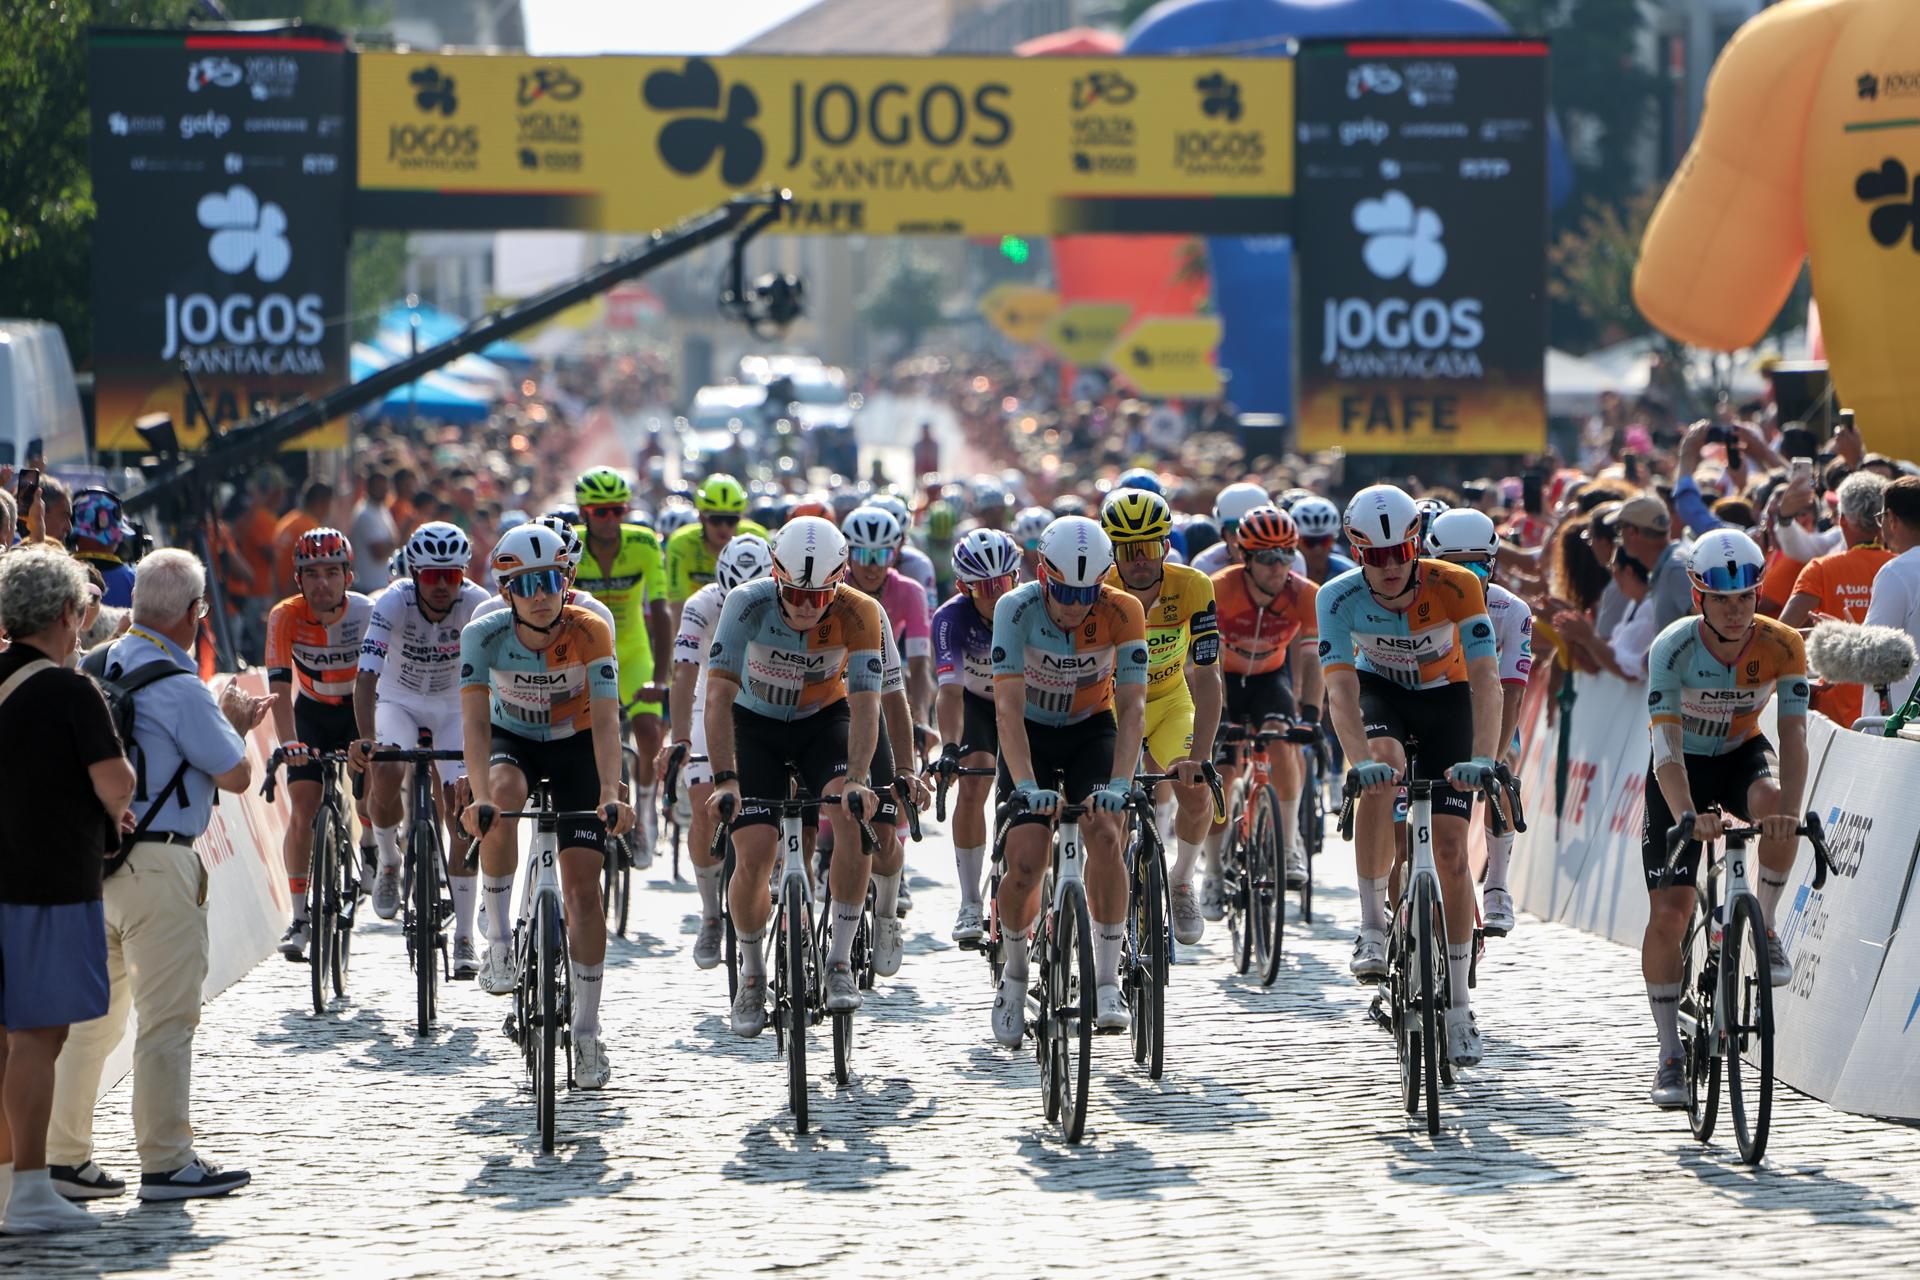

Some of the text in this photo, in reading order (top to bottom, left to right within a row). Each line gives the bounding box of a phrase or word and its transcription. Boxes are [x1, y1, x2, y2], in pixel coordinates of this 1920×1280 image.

[785, 80, 1013, 170] JOGOS
[387, 125, 479, 163] JOGOS
[1174, 130, 1265, 168] JOGOS
[811, 156, 1013, 191] SANTACASA
[786, 199, 867, 230] FAFE
[161, 292, 325, 361] JOGOS
[1321, 297, 1484, 364] JOGOS
[184, 346, 324, 374] SANTACASA
[1338, 351, 1484, 378] SANTACASA
[1340, 393, 1462, 434] FAFE
[1836, 585, 1868, 595] A tua
[940, 621, 949, 649] CORTIZO
[1376, 636, 1432, 650] NSN
[402, 643, 460, 655] FEIRA DOS
[771, 650, 824, 668] NSN
[1043, 654, 1096, 669] NSN
[514, 673, 567, 685] NSN
[1701, 691, 1755, 700] NSN
[834, 763, 847, 772] JIN
[1092, 783, 1110, 791] JIN
[1445, 796, 1468, 810] JINGA
[573, 829, 598, 841] JINGA
[1648, 865, 1688, 879] NN
[483, 884, 510, 894] NSN
